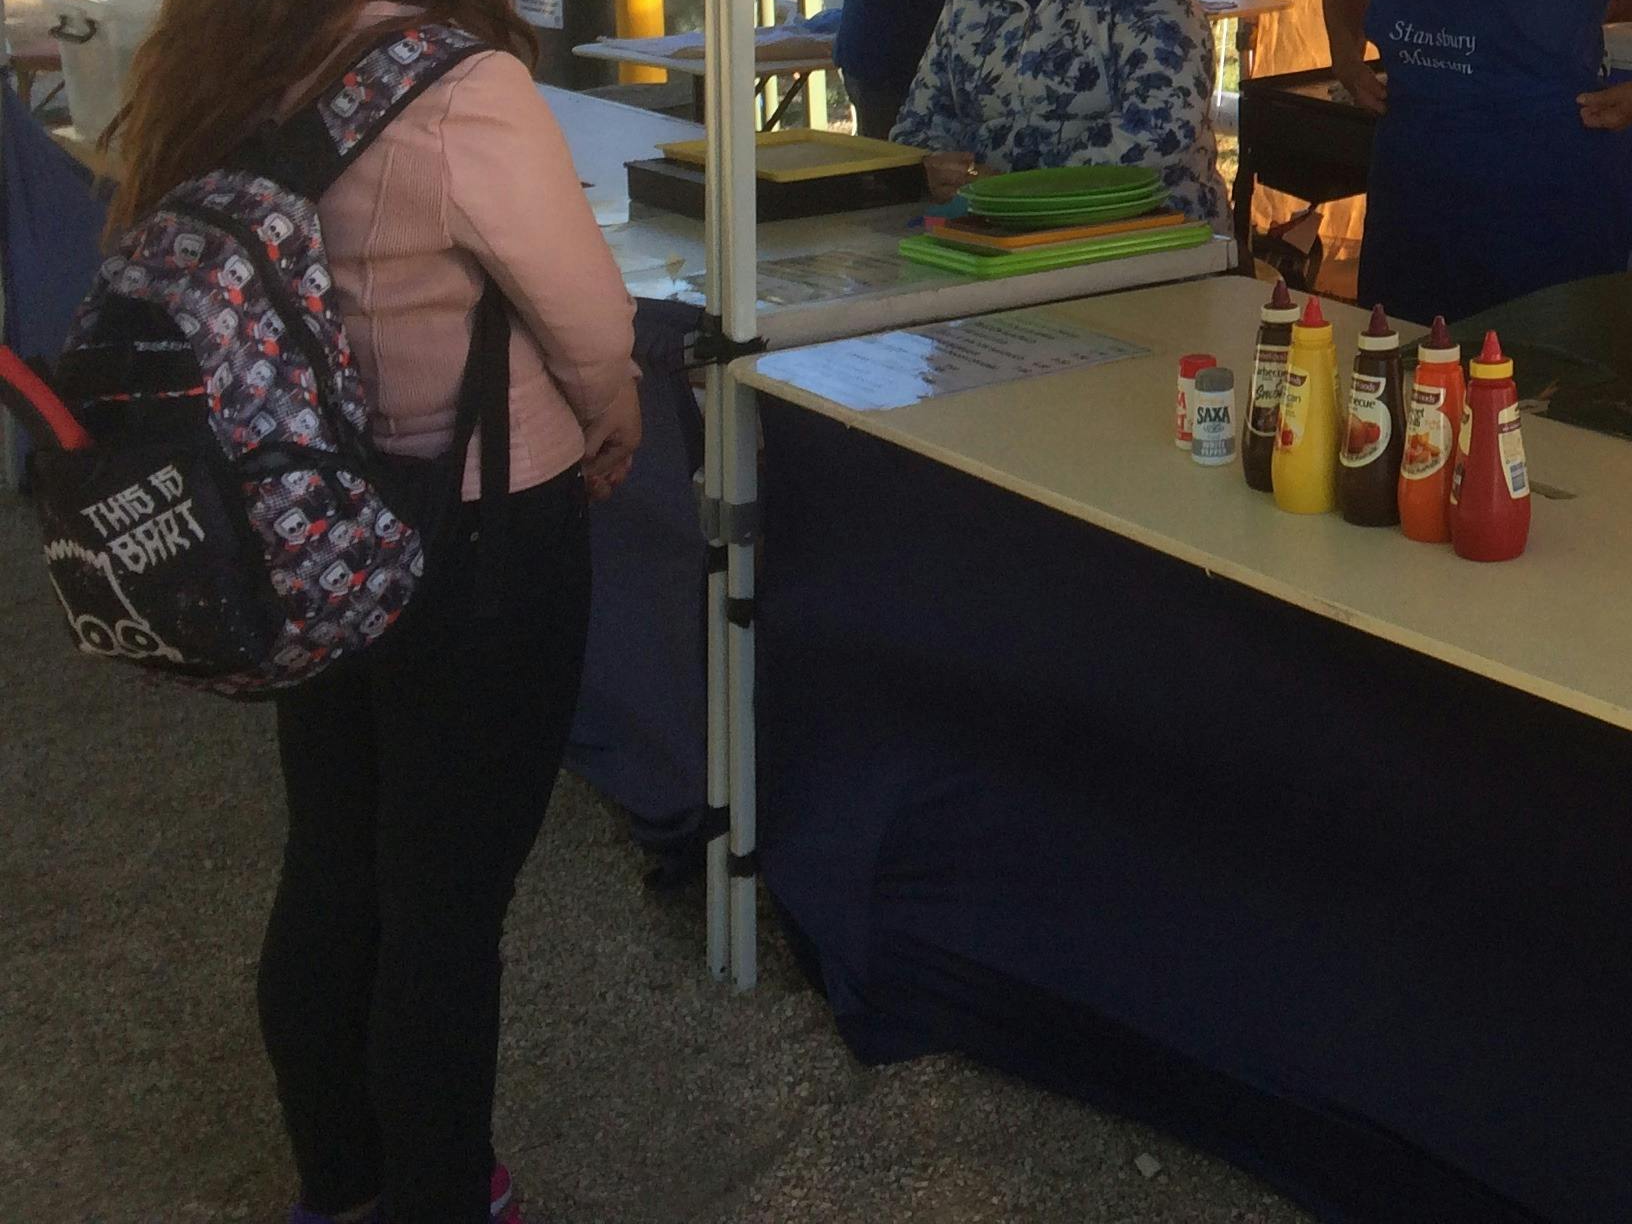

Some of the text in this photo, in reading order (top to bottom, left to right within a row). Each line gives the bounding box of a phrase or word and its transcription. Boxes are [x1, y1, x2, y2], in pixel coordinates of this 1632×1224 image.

[1389, 19, 1476, 56] Stansbury
[1399, 49, 1474, 75] Museum
[1197, 405, 1232, 425] SAXA
[80, 464, 184, 538] THIS IS
[105, 498, 206, 575] BART
